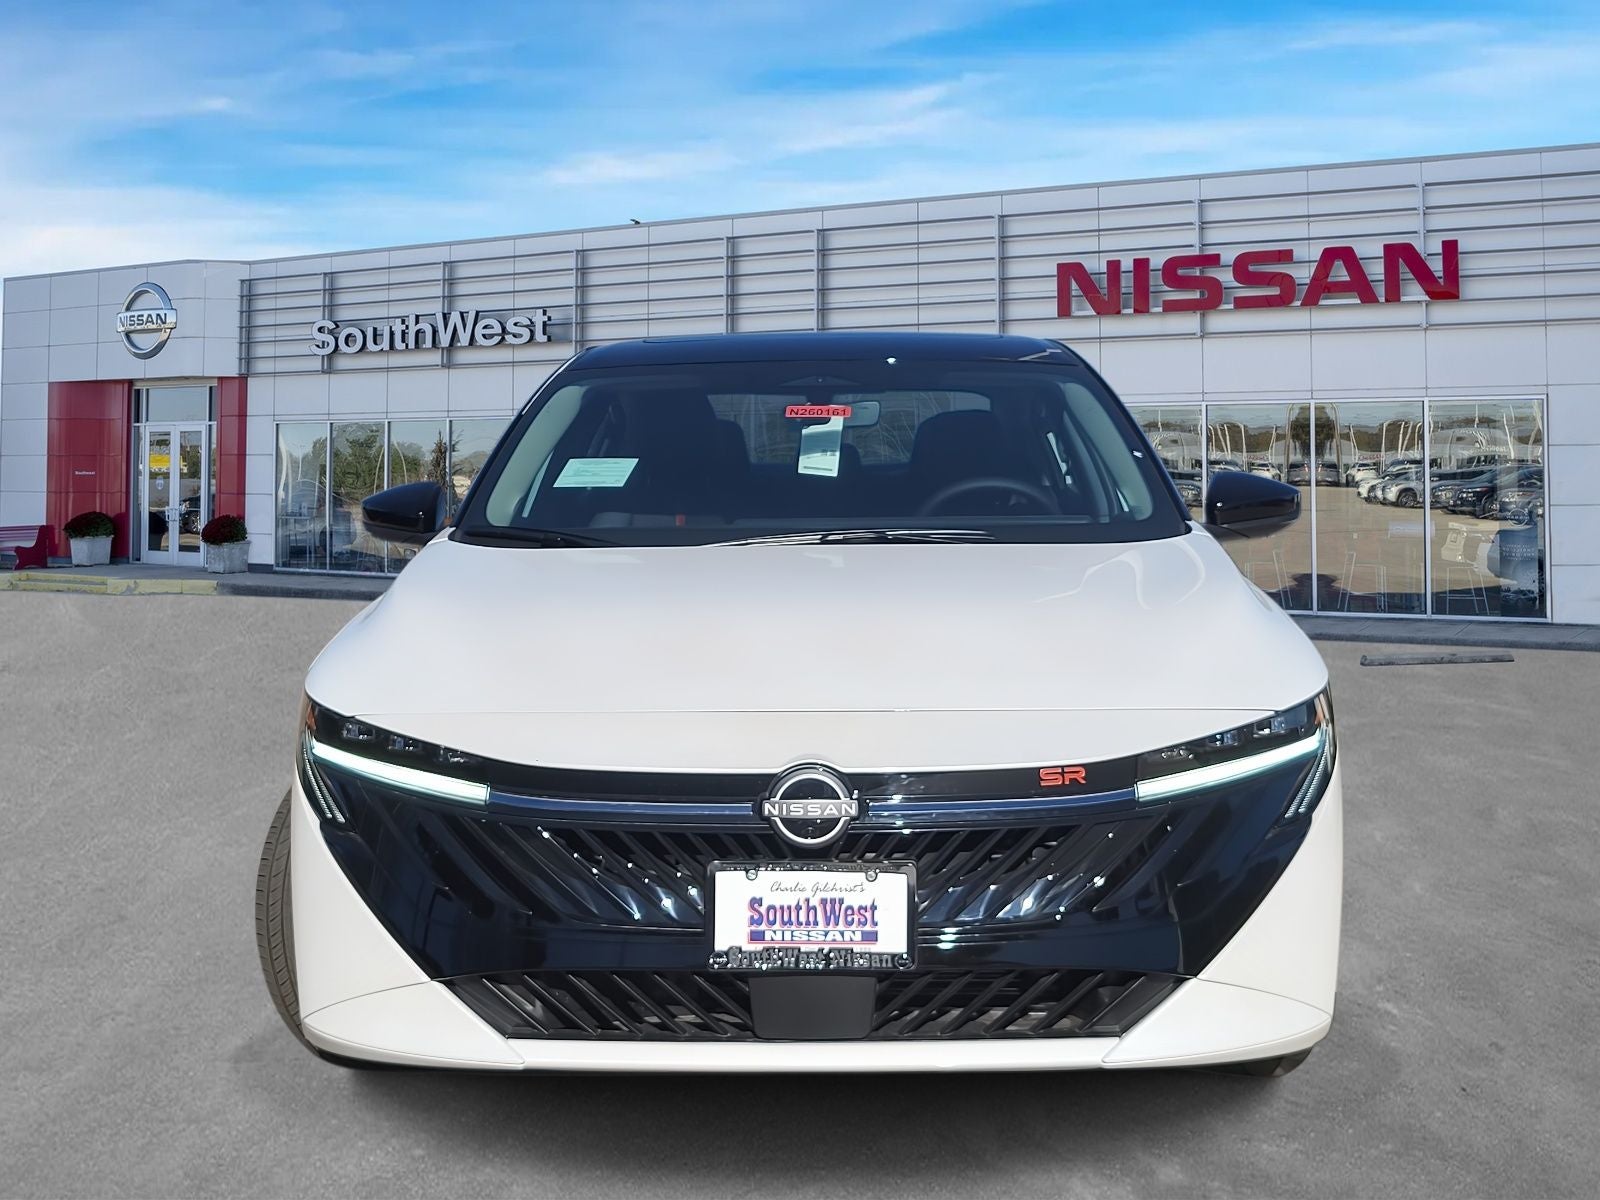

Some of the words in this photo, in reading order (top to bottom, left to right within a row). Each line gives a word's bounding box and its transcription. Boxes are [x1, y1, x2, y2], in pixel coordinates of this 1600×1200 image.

[1056, 239, 1461, 318] NISSAN
[119, 312, 167, 328] NISSAN
[309, 308, 551, 356] SouthWest
[1039, 766, 1087, 787] SR
[764, 802, 856, 816] NISSAN
[770, 880, 807, 893] Charlie
[811, 881, 866, 898] Gilchrist's
[748, 896, 878, 928] SouthWest
[764, 930, 862, 942] NISSAN
